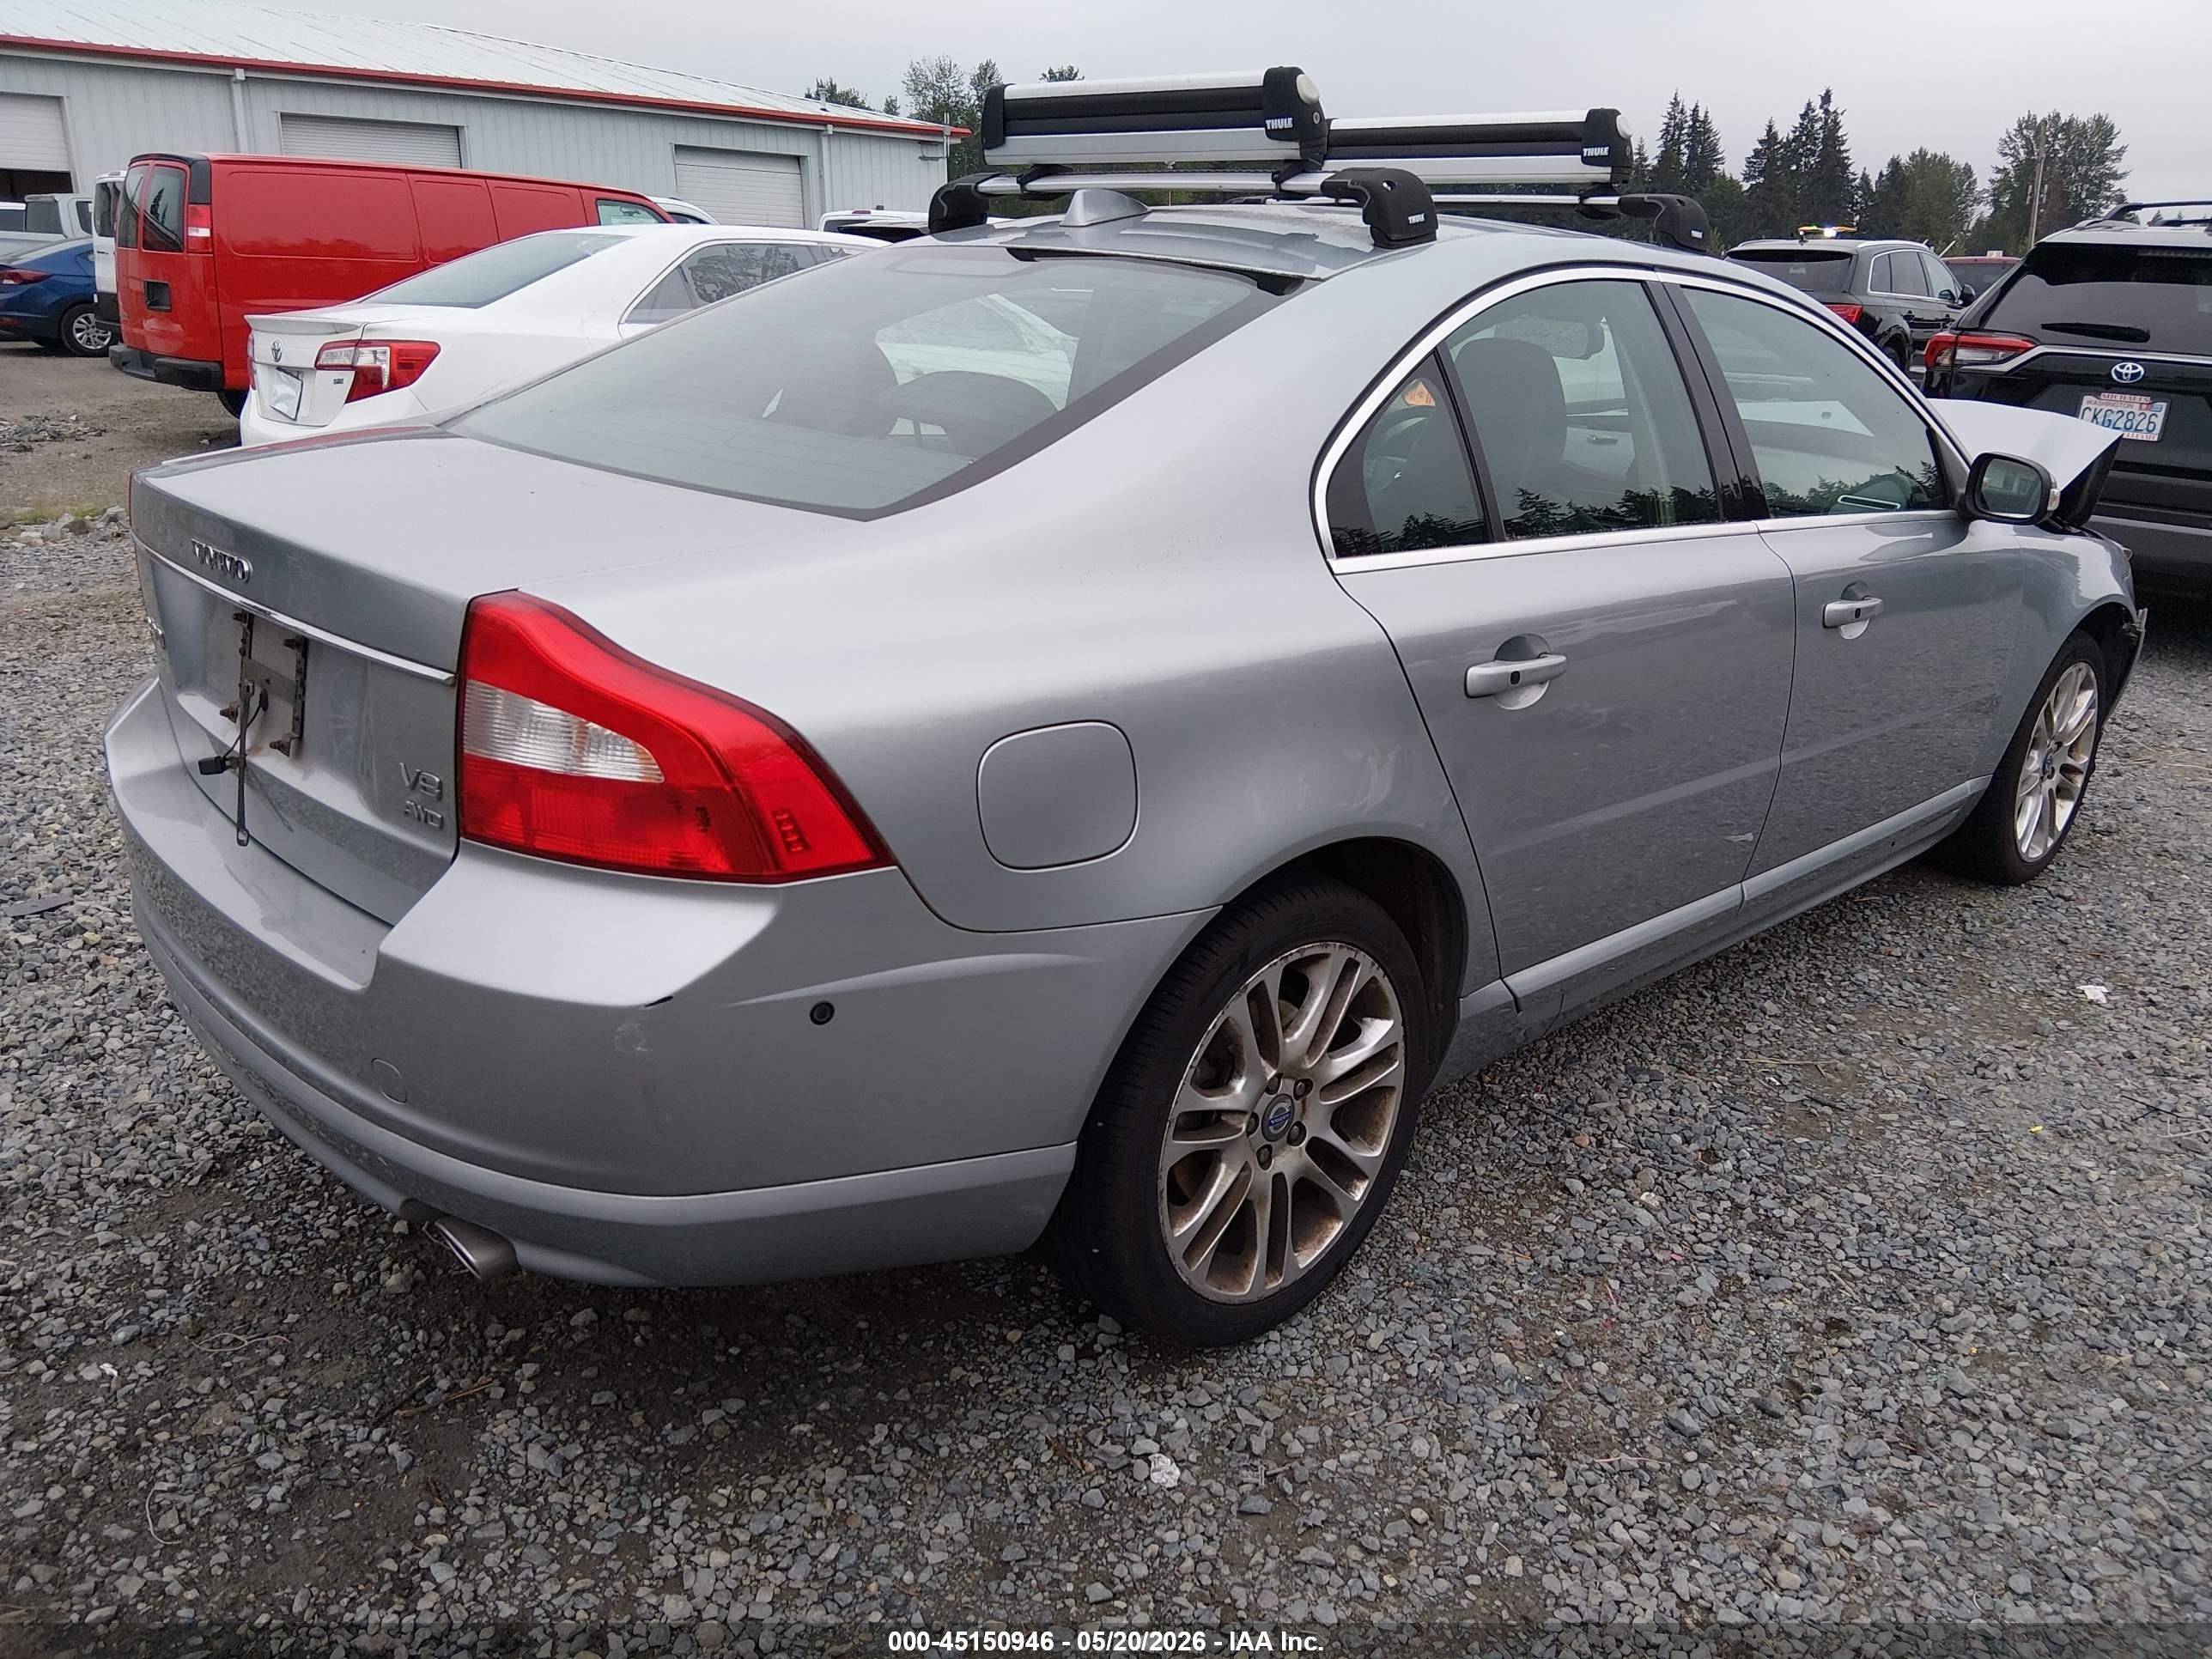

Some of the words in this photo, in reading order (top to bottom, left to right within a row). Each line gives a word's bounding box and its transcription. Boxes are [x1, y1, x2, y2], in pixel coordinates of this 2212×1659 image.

[1265, 117, 1293, 130] THULE
[1583, 146, 1609, 156] THULE
[2086, 399, 2134, 409] WASHINGTON
[2081, 406, 2158, 433] CKG2826
[191, 538, 253, 582] VOLVO
[399, 763, 443, 801] V8
[404, 801, 444, 830] AWD
